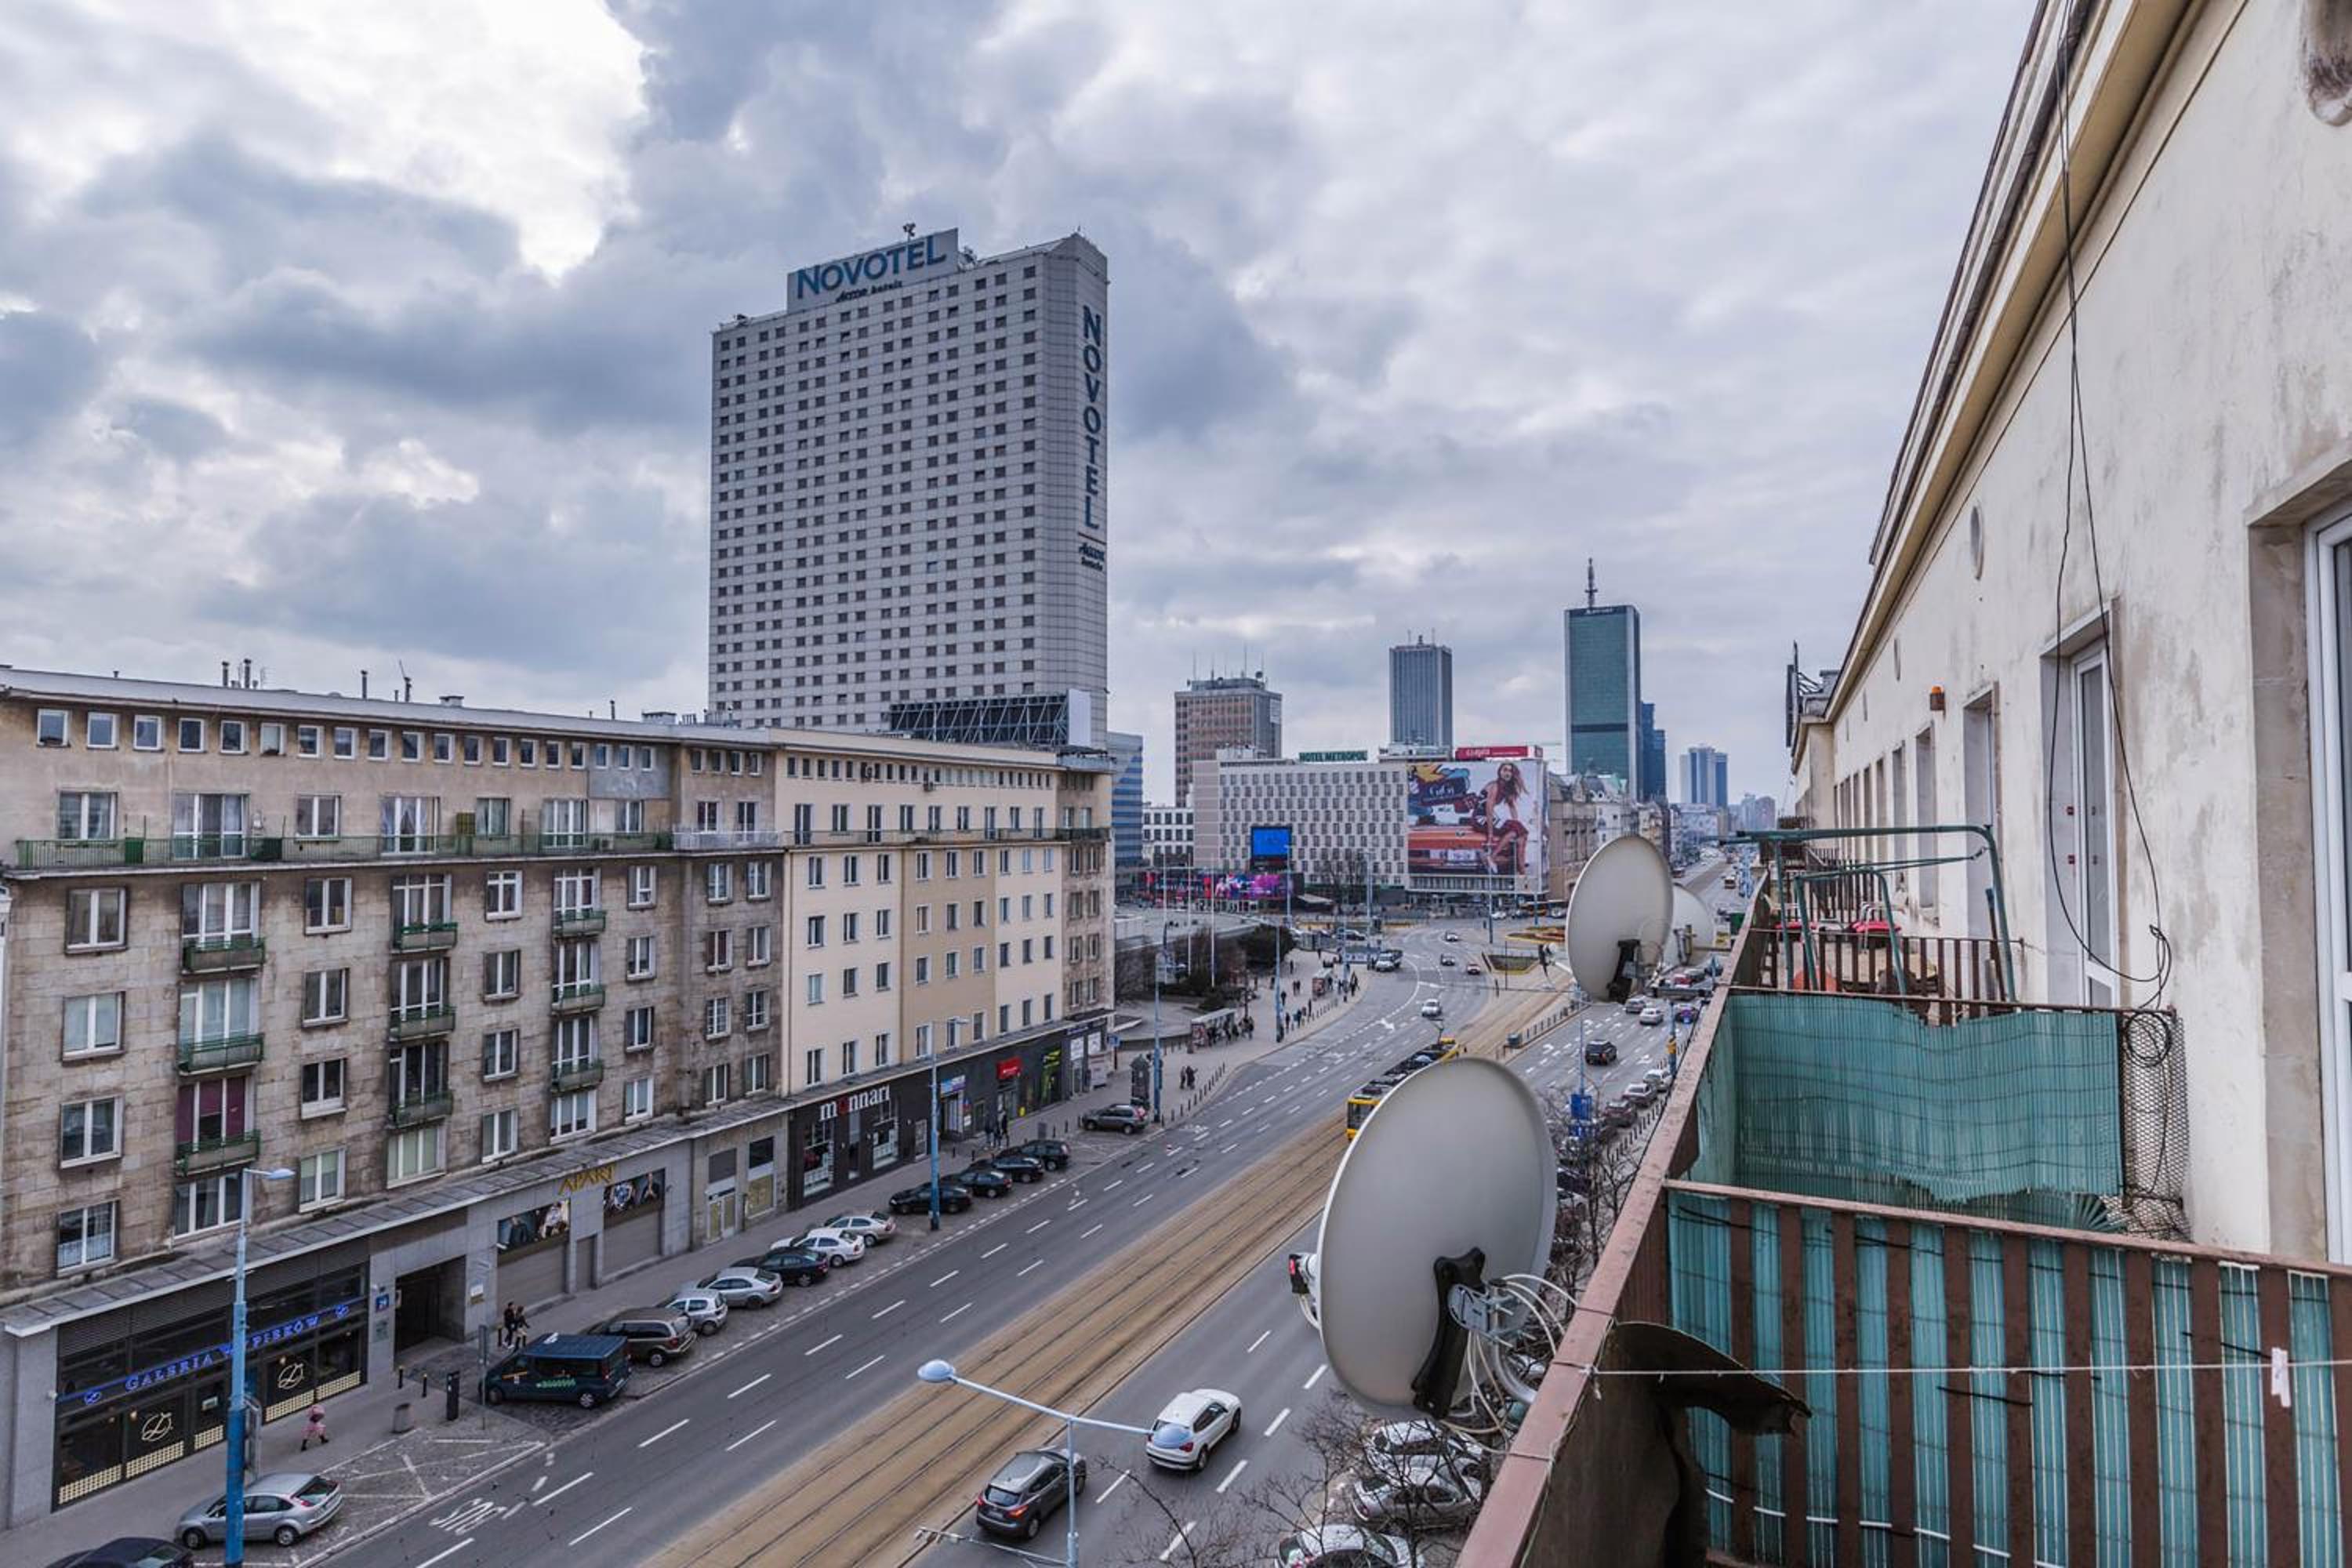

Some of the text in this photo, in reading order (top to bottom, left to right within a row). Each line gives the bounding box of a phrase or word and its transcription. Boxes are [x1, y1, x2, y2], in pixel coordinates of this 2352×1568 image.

[797, 235, 946, 299] NOVOTEL
[1083, 304, 1102, 529] NOVOTEL
[1298, 752, 1323, 762] HOTEL
[125, 1354, 214, 1392] GALERIA
